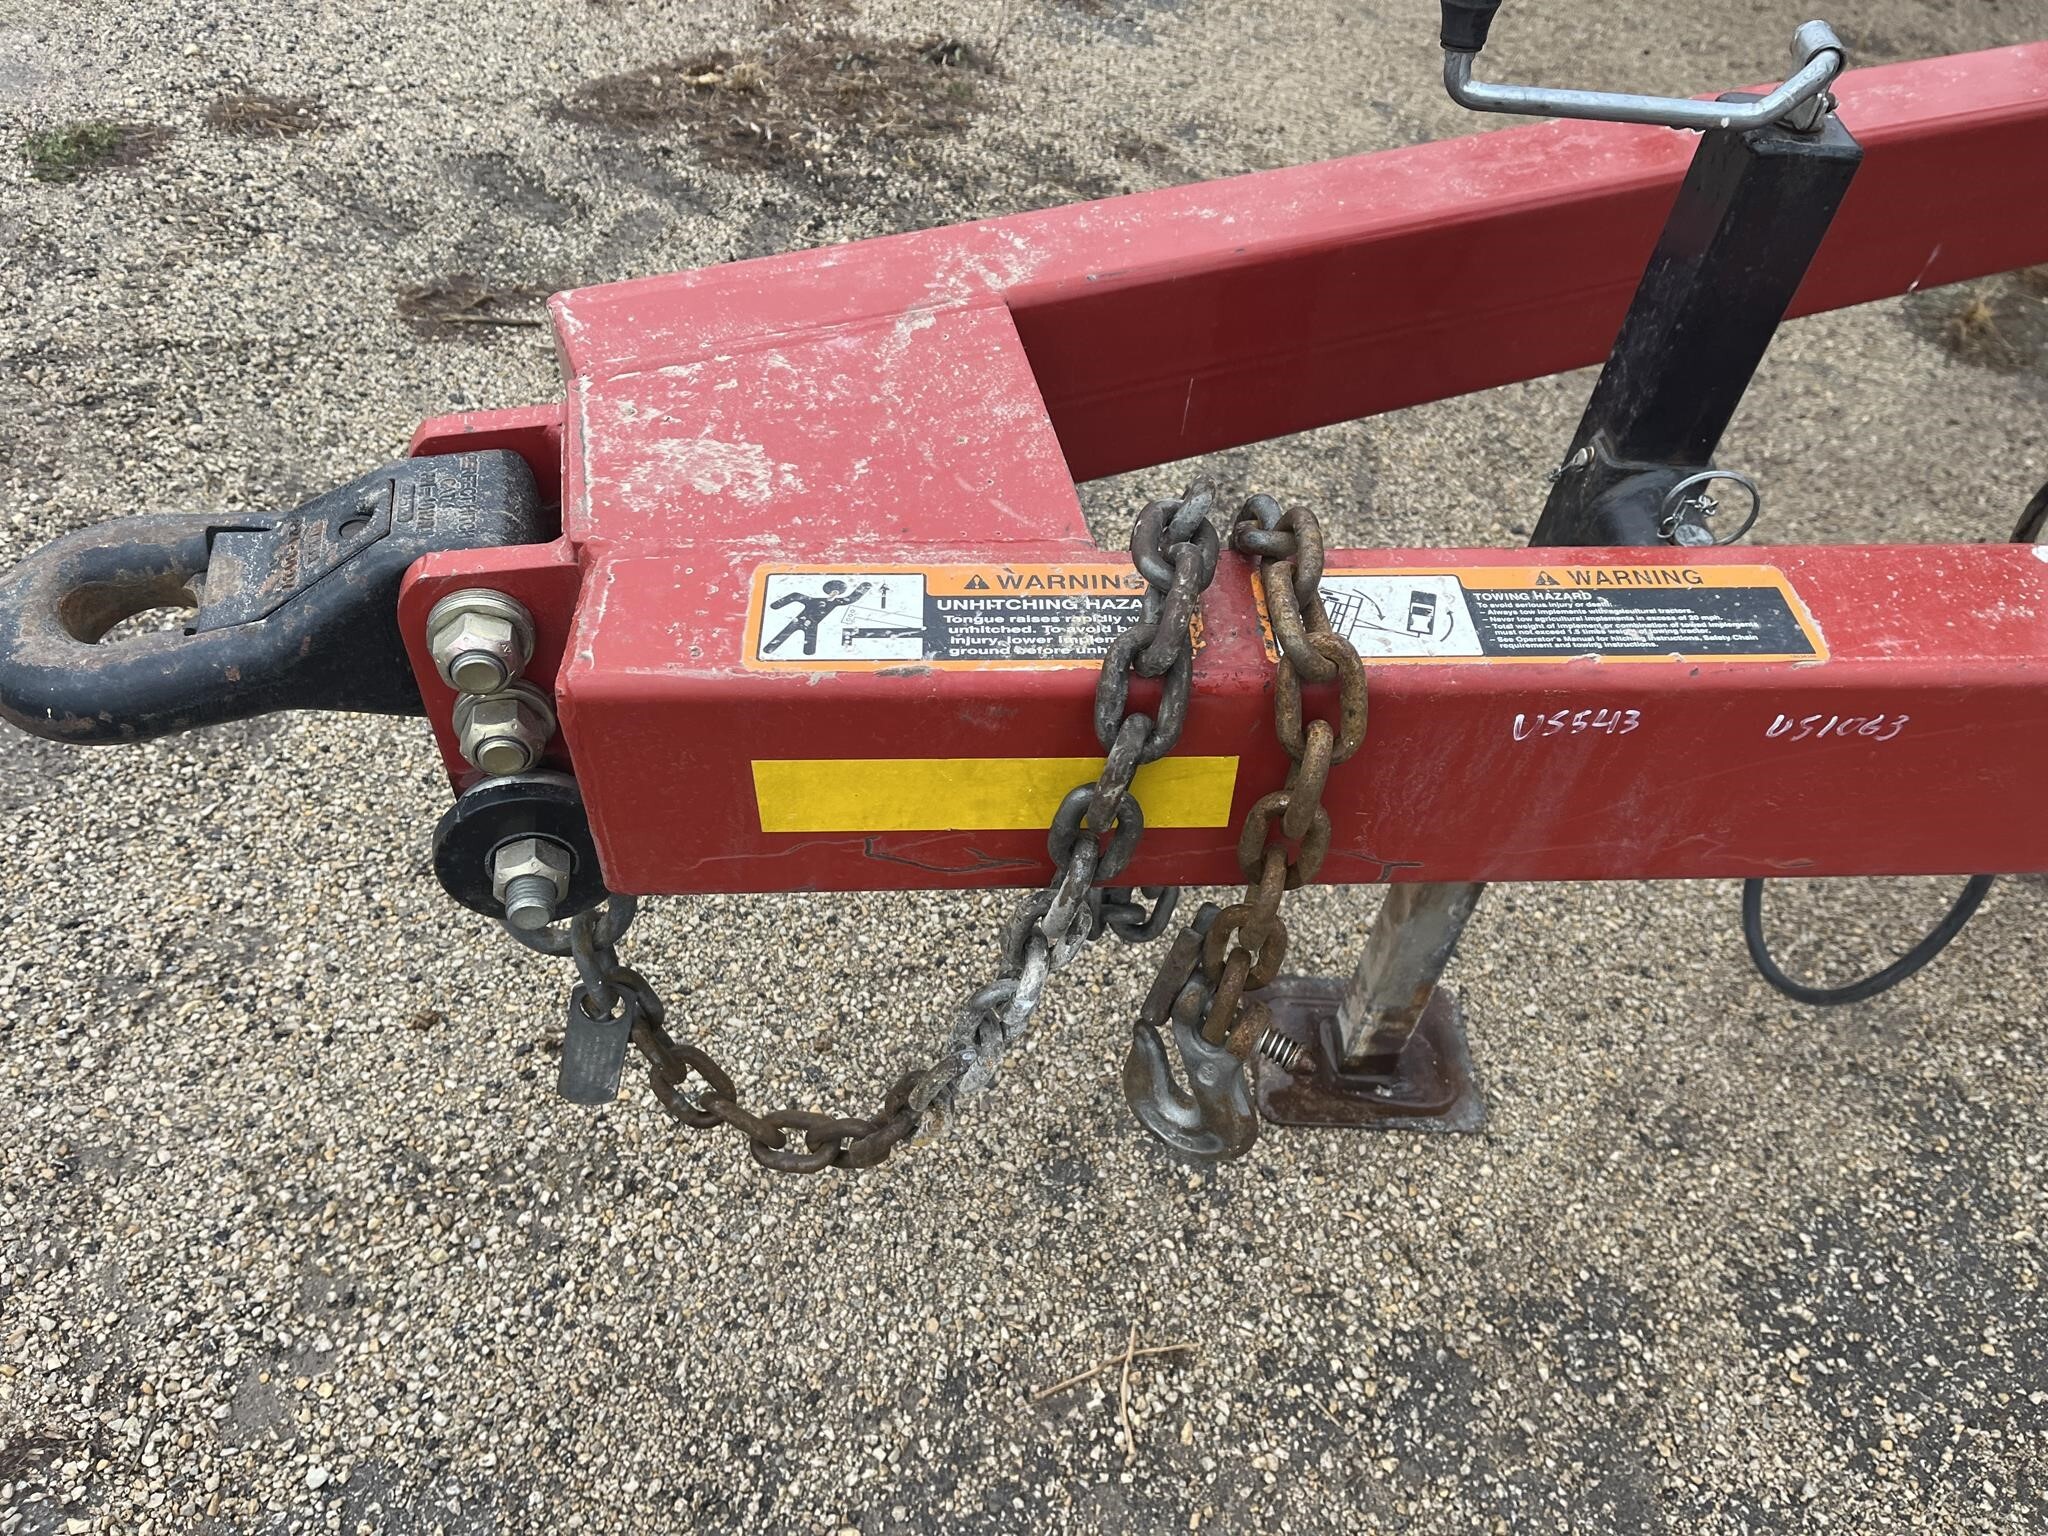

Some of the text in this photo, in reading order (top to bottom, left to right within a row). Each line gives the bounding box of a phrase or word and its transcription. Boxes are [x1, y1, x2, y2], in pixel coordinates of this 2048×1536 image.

[996, 574, 1145, 590] WARNING
[1566, 569, 1704, 585] WARNING
[1472, 591, 1592, 601] TOWING HAZARD
[936, 598, 1143, 611] UNHITCHING HAZA
[943, 615, 1005, 625] Tongue
[1009, 614, 1061, 623] raises
[1065, 614, 1122, 624] rapidly
[948, 625, 1037, 634] unhitched.
[1041, 625, 1061, 634] To
[1066, 624, 1112, 633] avoid
[1007, 635, 1054, 645] lower
[1058, 635, 1117, 645] implem
[948, 646, 1011, 657] ground
[1013, 646, 1074, 655] before
[1512, 708, 1911, 743] US543 US1063
